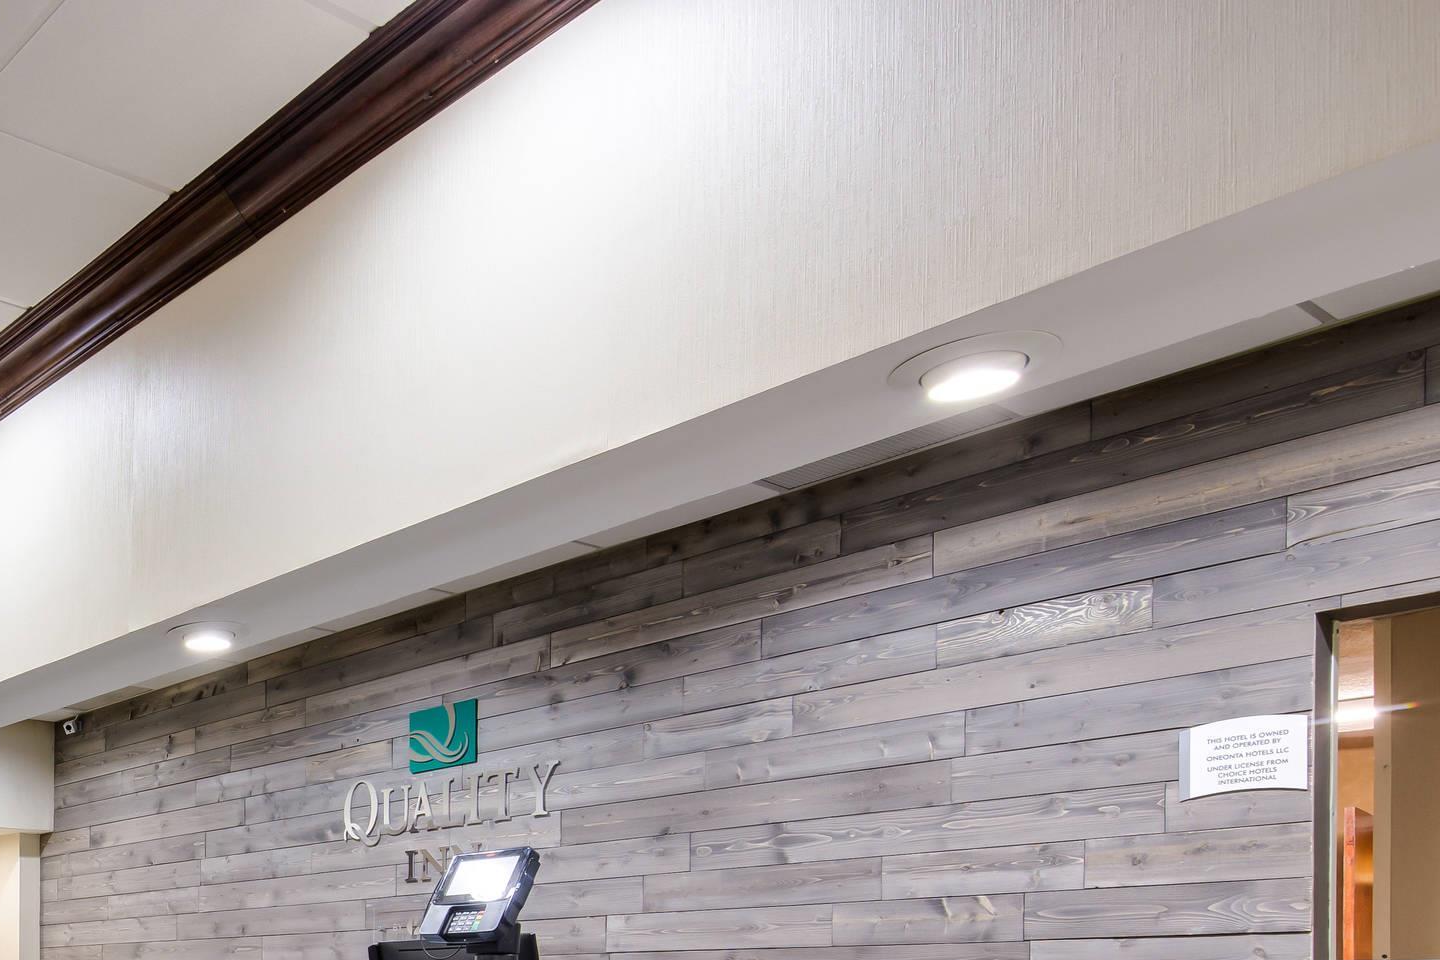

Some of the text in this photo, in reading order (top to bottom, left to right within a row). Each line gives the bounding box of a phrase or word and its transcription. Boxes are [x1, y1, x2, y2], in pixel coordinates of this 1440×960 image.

[1207, 729, 1289, 745] THIS HOTEL IS OWNED
[1232, 739, 1270, 749] OPERATED
[1272, 737, 1282, 745] BY
[1206, 746, 1289, 762] ONEONTA HOTELS LLC
[1207, 758, 1289, 773] UNDER LICENSE FROM
[1217, 766, 1278, 779] CHOICE HOTELS
[1217, 774, 1277, 786] INTERNATIONAL
[344, 759, 561, 847] QUALITY
[404, 841, 483, 883] IN
